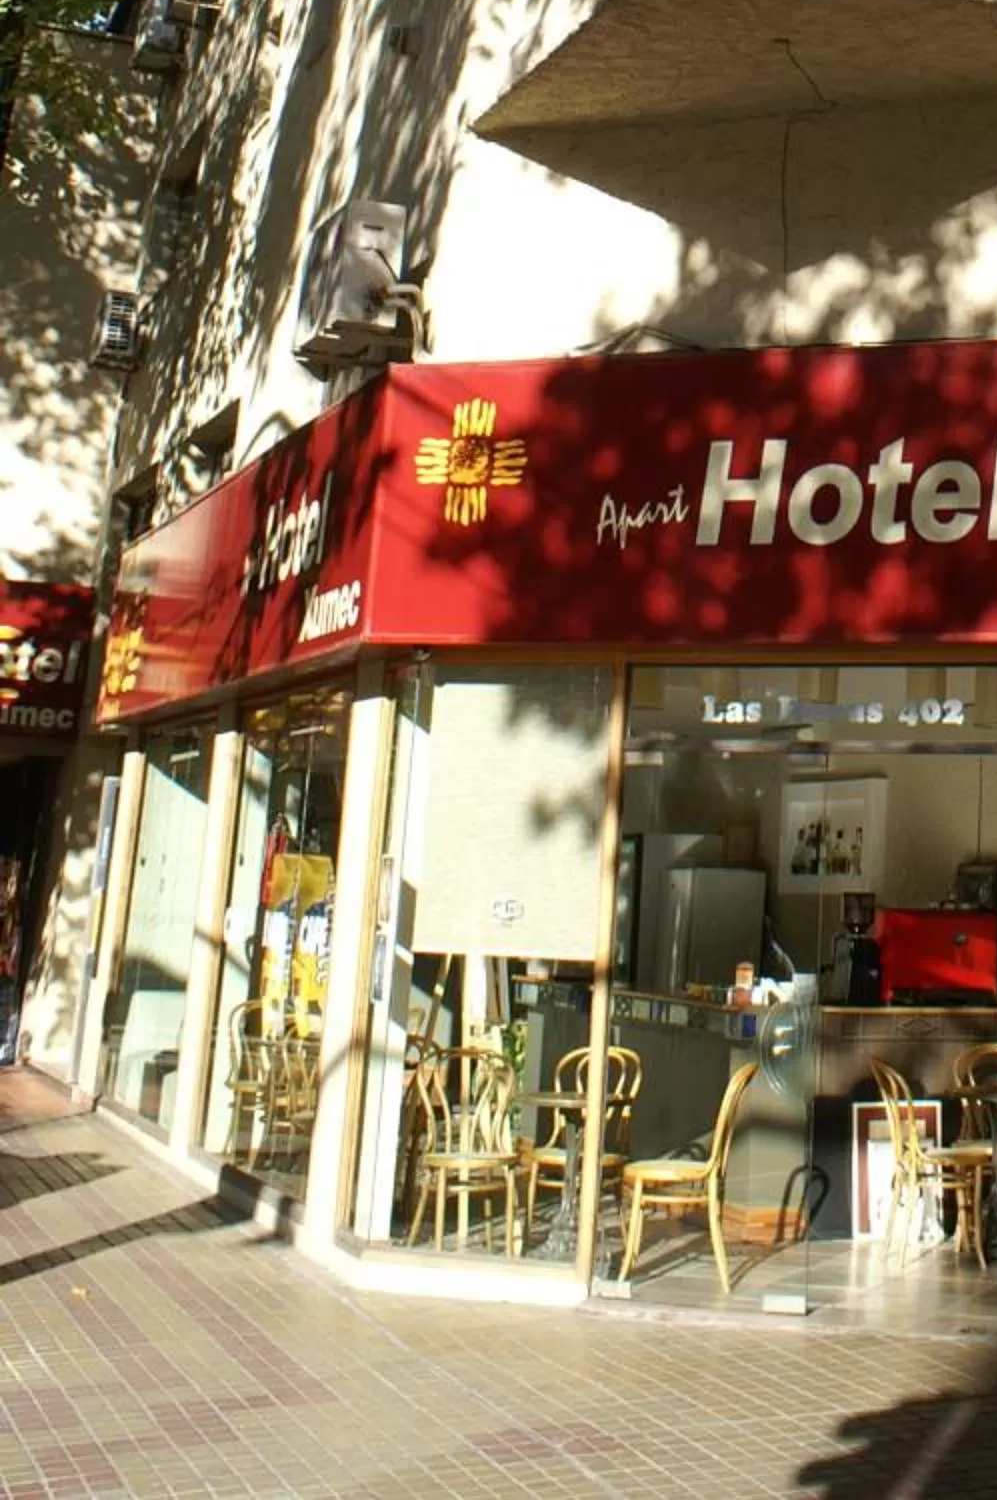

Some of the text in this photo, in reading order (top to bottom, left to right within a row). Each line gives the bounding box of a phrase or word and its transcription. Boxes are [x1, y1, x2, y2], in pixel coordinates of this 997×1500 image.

[258, 469, 333, 591] Hotel
[596, 483, 689, 550] Apart
[297, 579, 362, 644] Xumec
[702, 694, 762, 723] Las
[897, 696, 965, 727] 402
